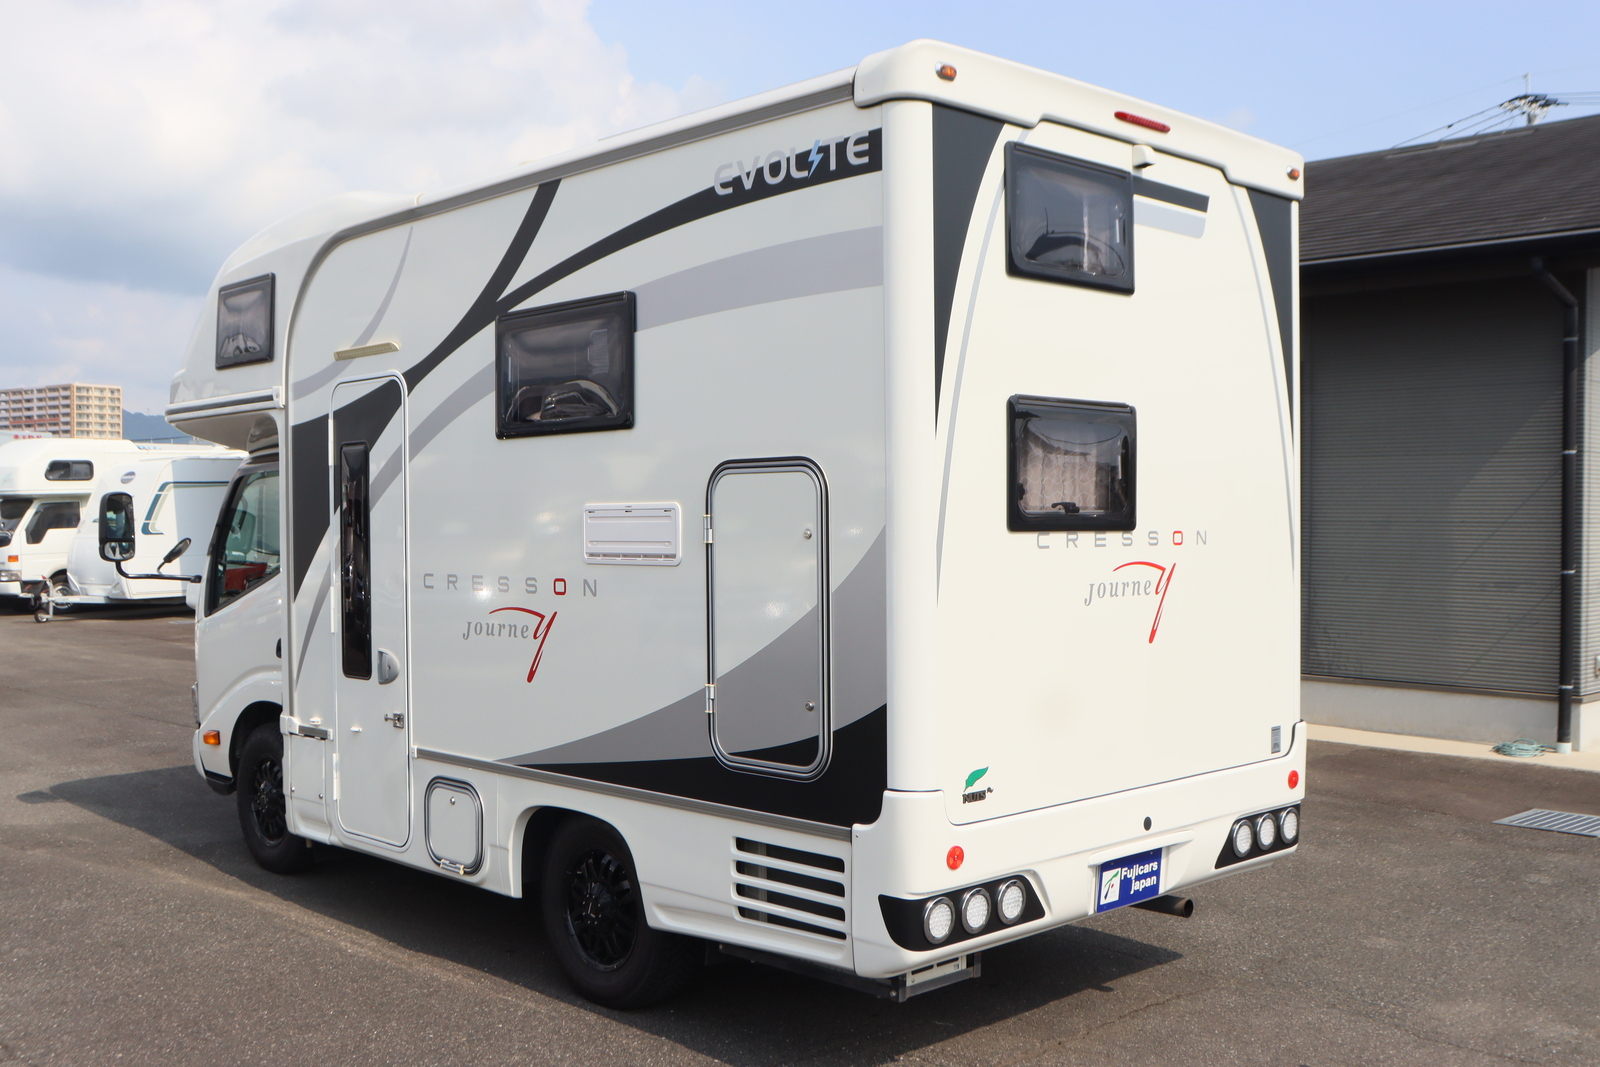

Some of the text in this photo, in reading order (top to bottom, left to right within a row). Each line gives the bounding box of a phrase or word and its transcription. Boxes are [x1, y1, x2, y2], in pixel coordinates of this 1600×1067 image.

[713, 129, 869, 196] EVOLITE
[1036, 530, 1208, 550] CRESSON
[423, 573, 598, 598] CRESSON
[1121, 861, 1159, 880] Fujicars
